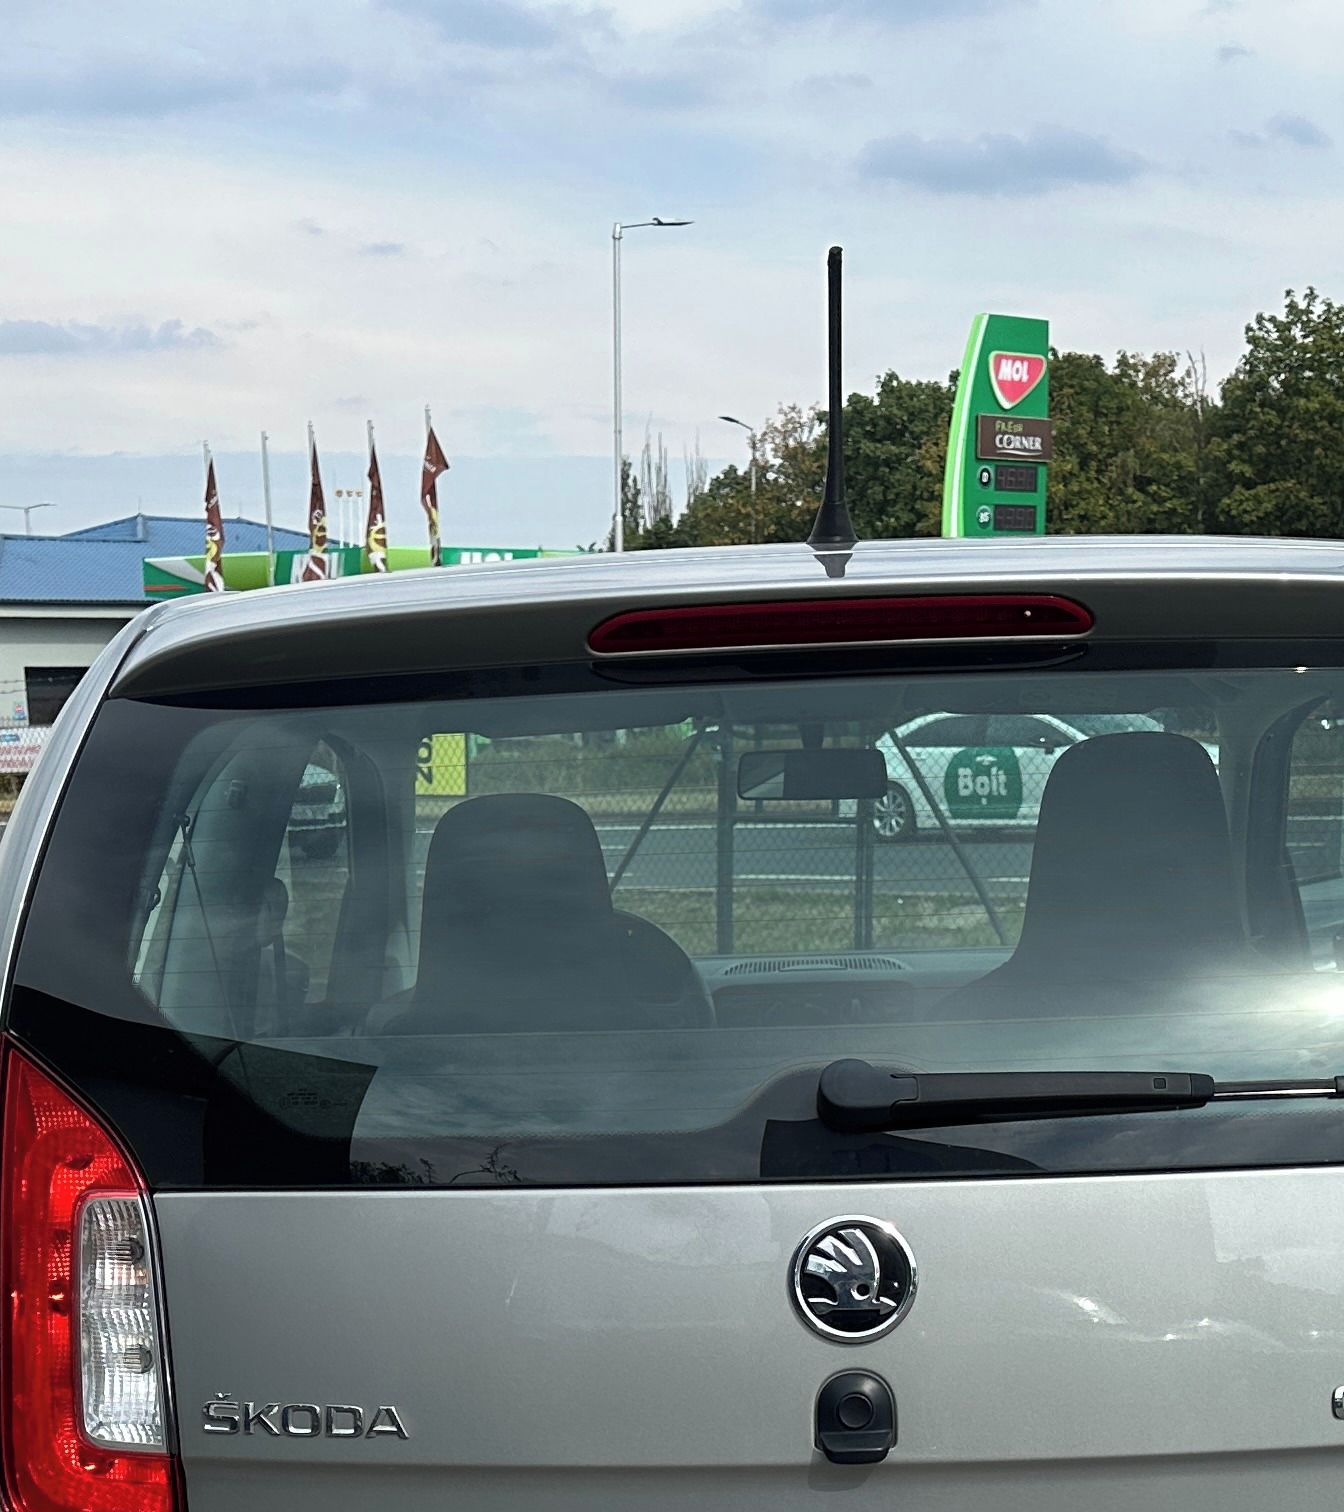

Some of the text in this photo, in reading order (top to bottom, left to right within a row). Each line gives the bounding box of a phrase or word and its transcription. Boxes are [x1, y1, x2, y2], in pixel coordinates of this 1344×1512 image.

[998, 359, 1029, 382] MOL
[994, 434, 1043, 451] CORNER
[957, 766, 1008, 799] Bolt
[202, 1392, 410, 1440] ŠKODA
